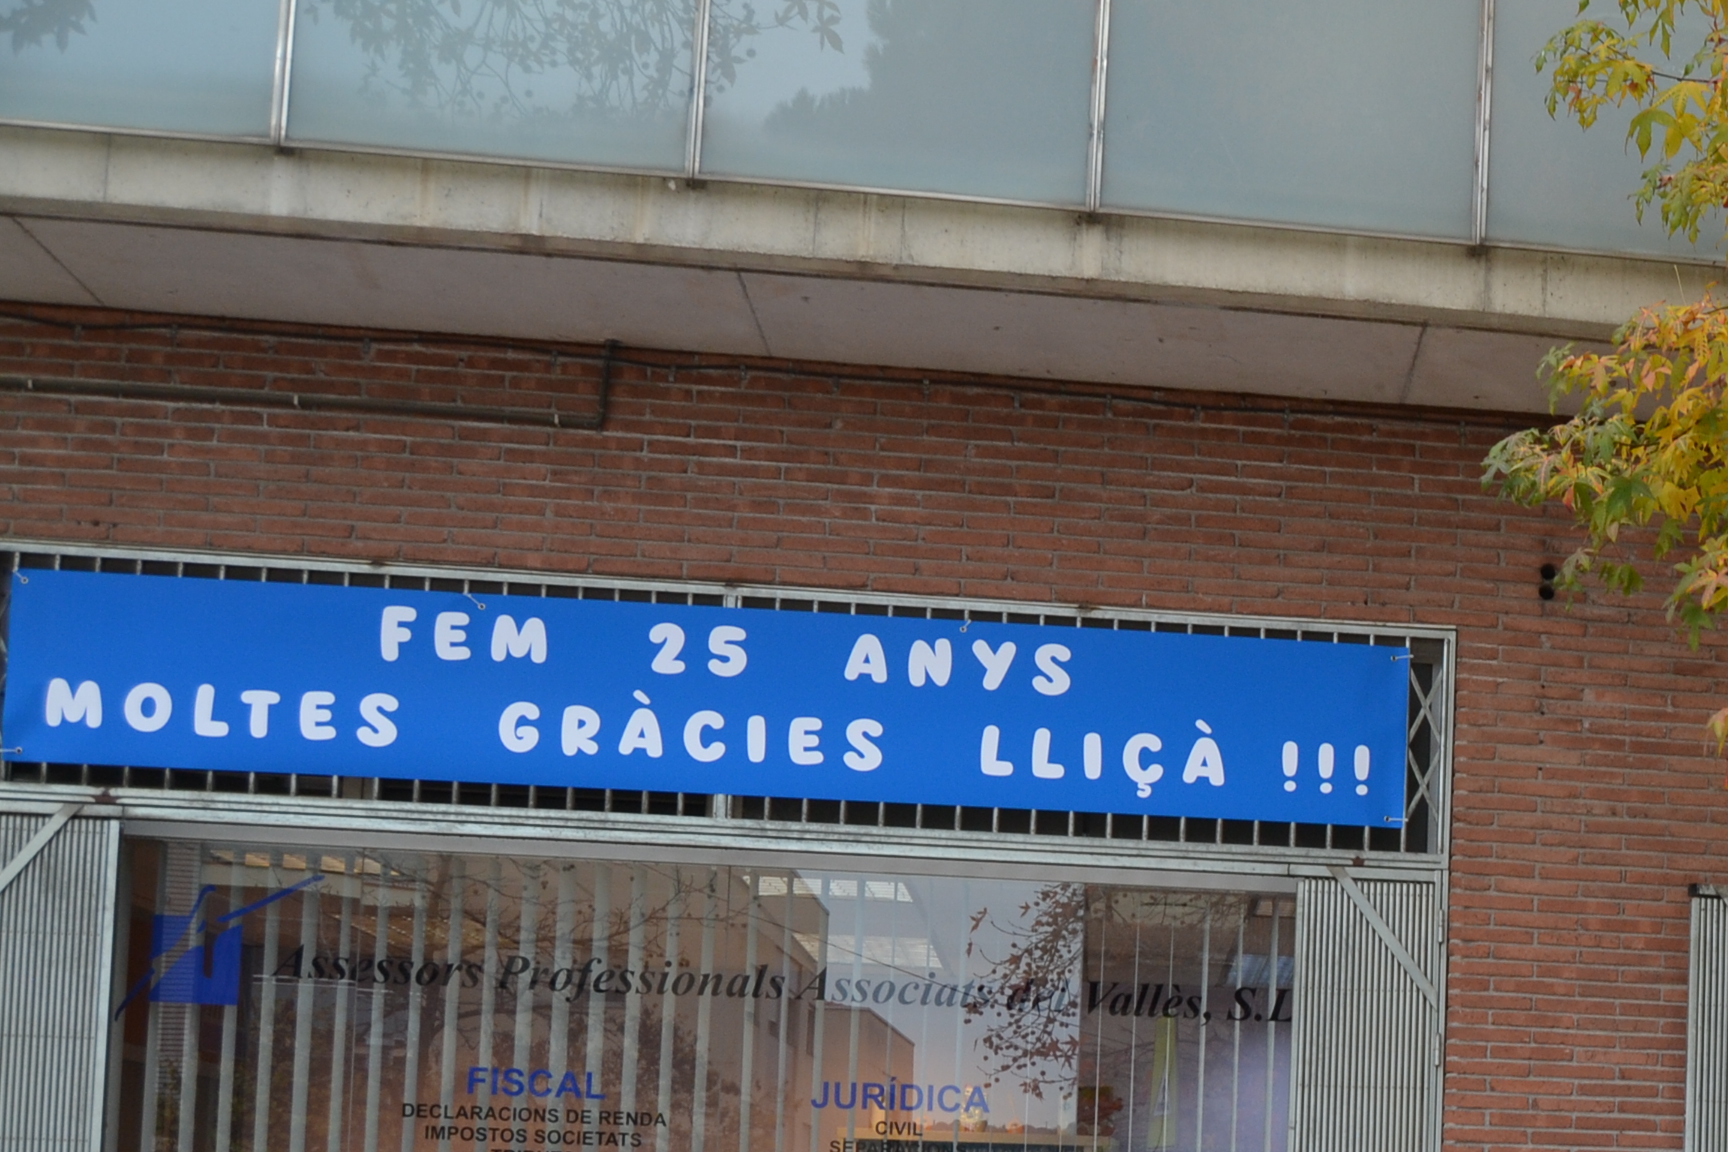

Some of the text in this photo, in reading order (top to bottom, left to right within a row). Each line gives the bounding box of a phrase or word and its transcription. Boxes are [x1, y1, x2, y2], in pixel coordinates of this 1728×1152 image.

[380, 605, 1073, 696] FEM 25 ANYS
[45, 677, 399, 747] MOLTES
[498, 689, 884, 772] GRÀCIES
[980, 718, 1225, 798] LLIÇÀ
[272, 944, 485, 987] Assessors
[493, 955, 786, 1003] Professionals
[792, 966, 992, 1008] Associats
[1087, 980, 1211, 1027] Vallès,
[467, 1067, 605, 1100] FISCAL
[811, 1077, 990, 1114] JURÍDICA
[402, 1103, 667, 1127] DECLARACIONS DE RENDA
[875, 1121, 923, 1136] CIVIL
[424, 1125, 642, 1148] IMPOSTOS SOCIETATS
